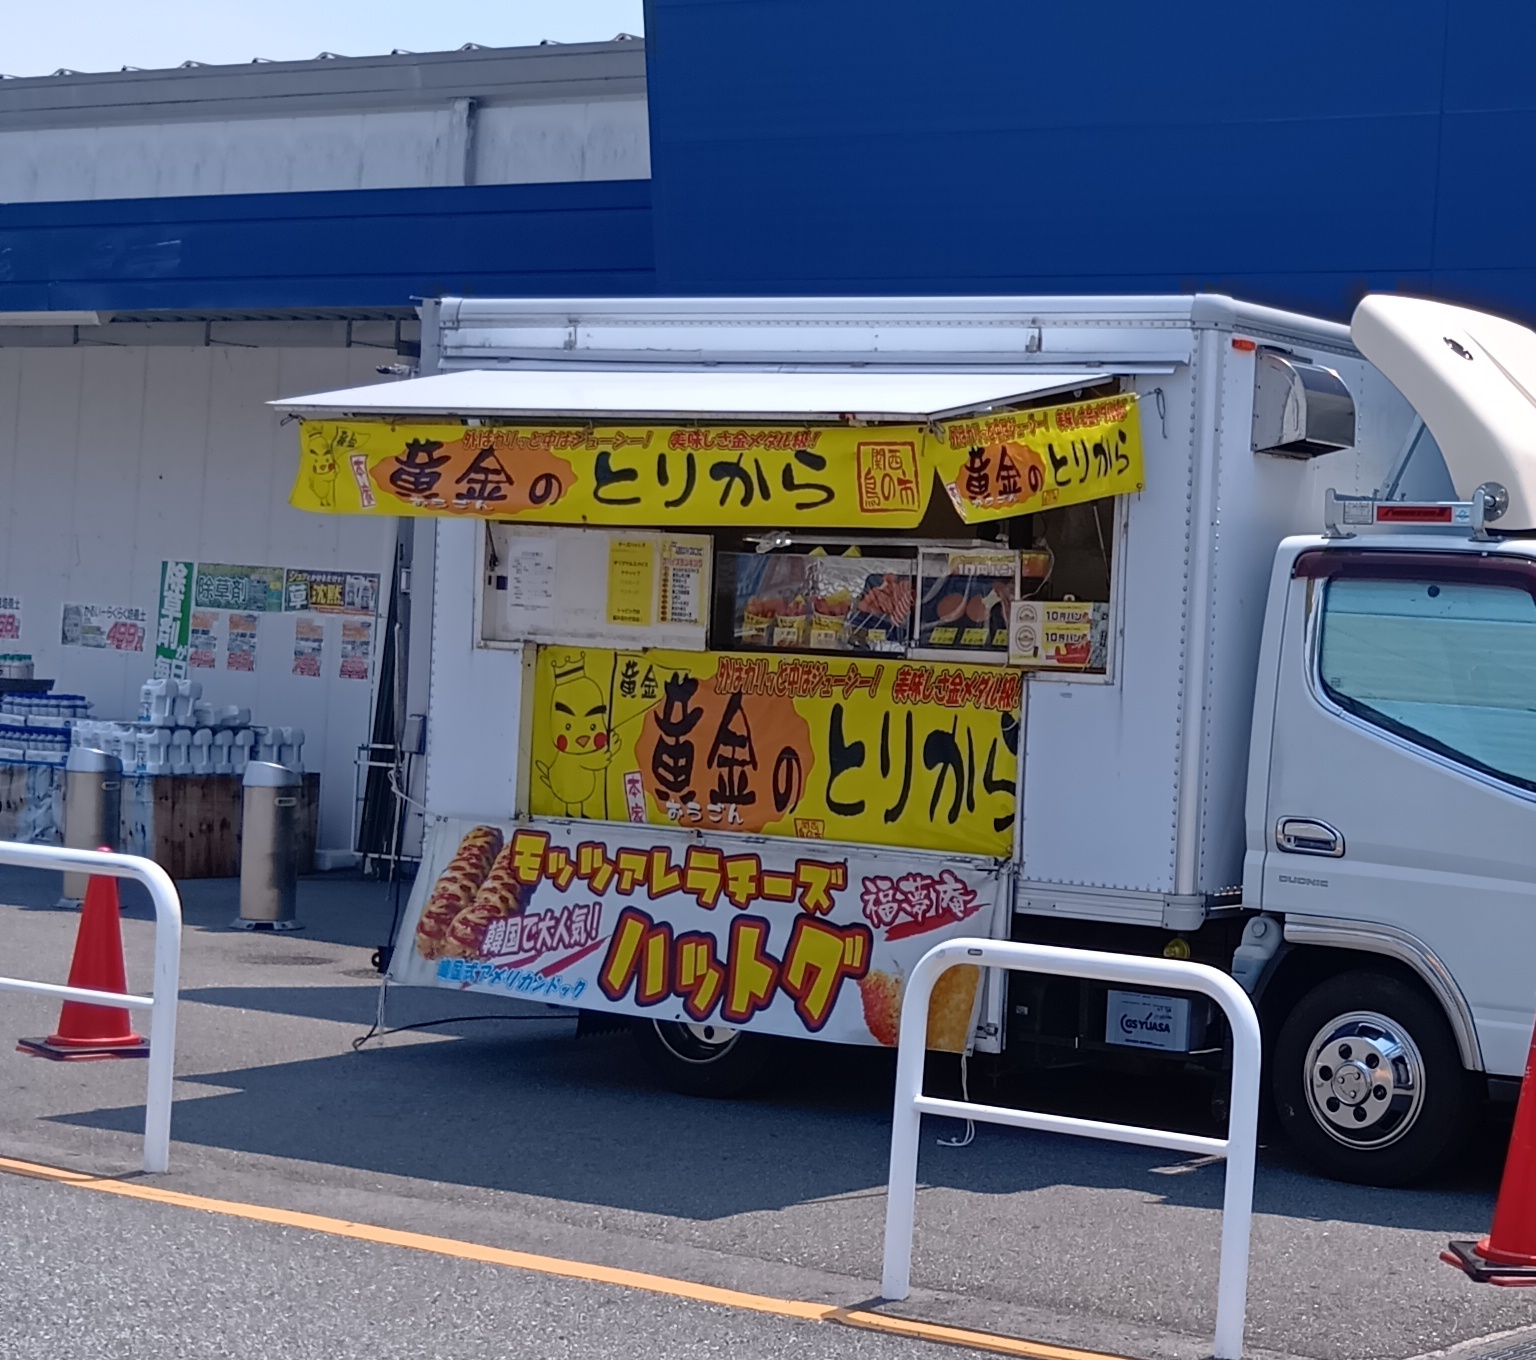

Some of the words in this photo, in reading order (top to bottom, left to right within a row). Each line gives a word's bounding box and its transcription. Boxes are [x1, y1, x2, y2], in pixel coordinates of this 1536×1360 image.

[389, 437, 835, 509] 黄金のとりから
[198, 576, 249, 603] 除草剤
[289, 584, 309, 609] 草
[620, 660, 659, 699] 黄金
[715, 656, 884, 699] 外はカリッと中はジューシー!
[651, 671, 1019, 833] 黄金のとりから
[666, 799, 744, 825] おうごん
[510, 829, 849, 915] モッツァレラチーズ
[1279, 874, 1329, 888] DUONIC
[861, 870, 977, 928] 福夢庵
[479, 902, 603, 956] 韓国で大人気!
[598, 905, 874, 1033] ハットグ
[1138, 1018, 1171, 1034] YUASA
